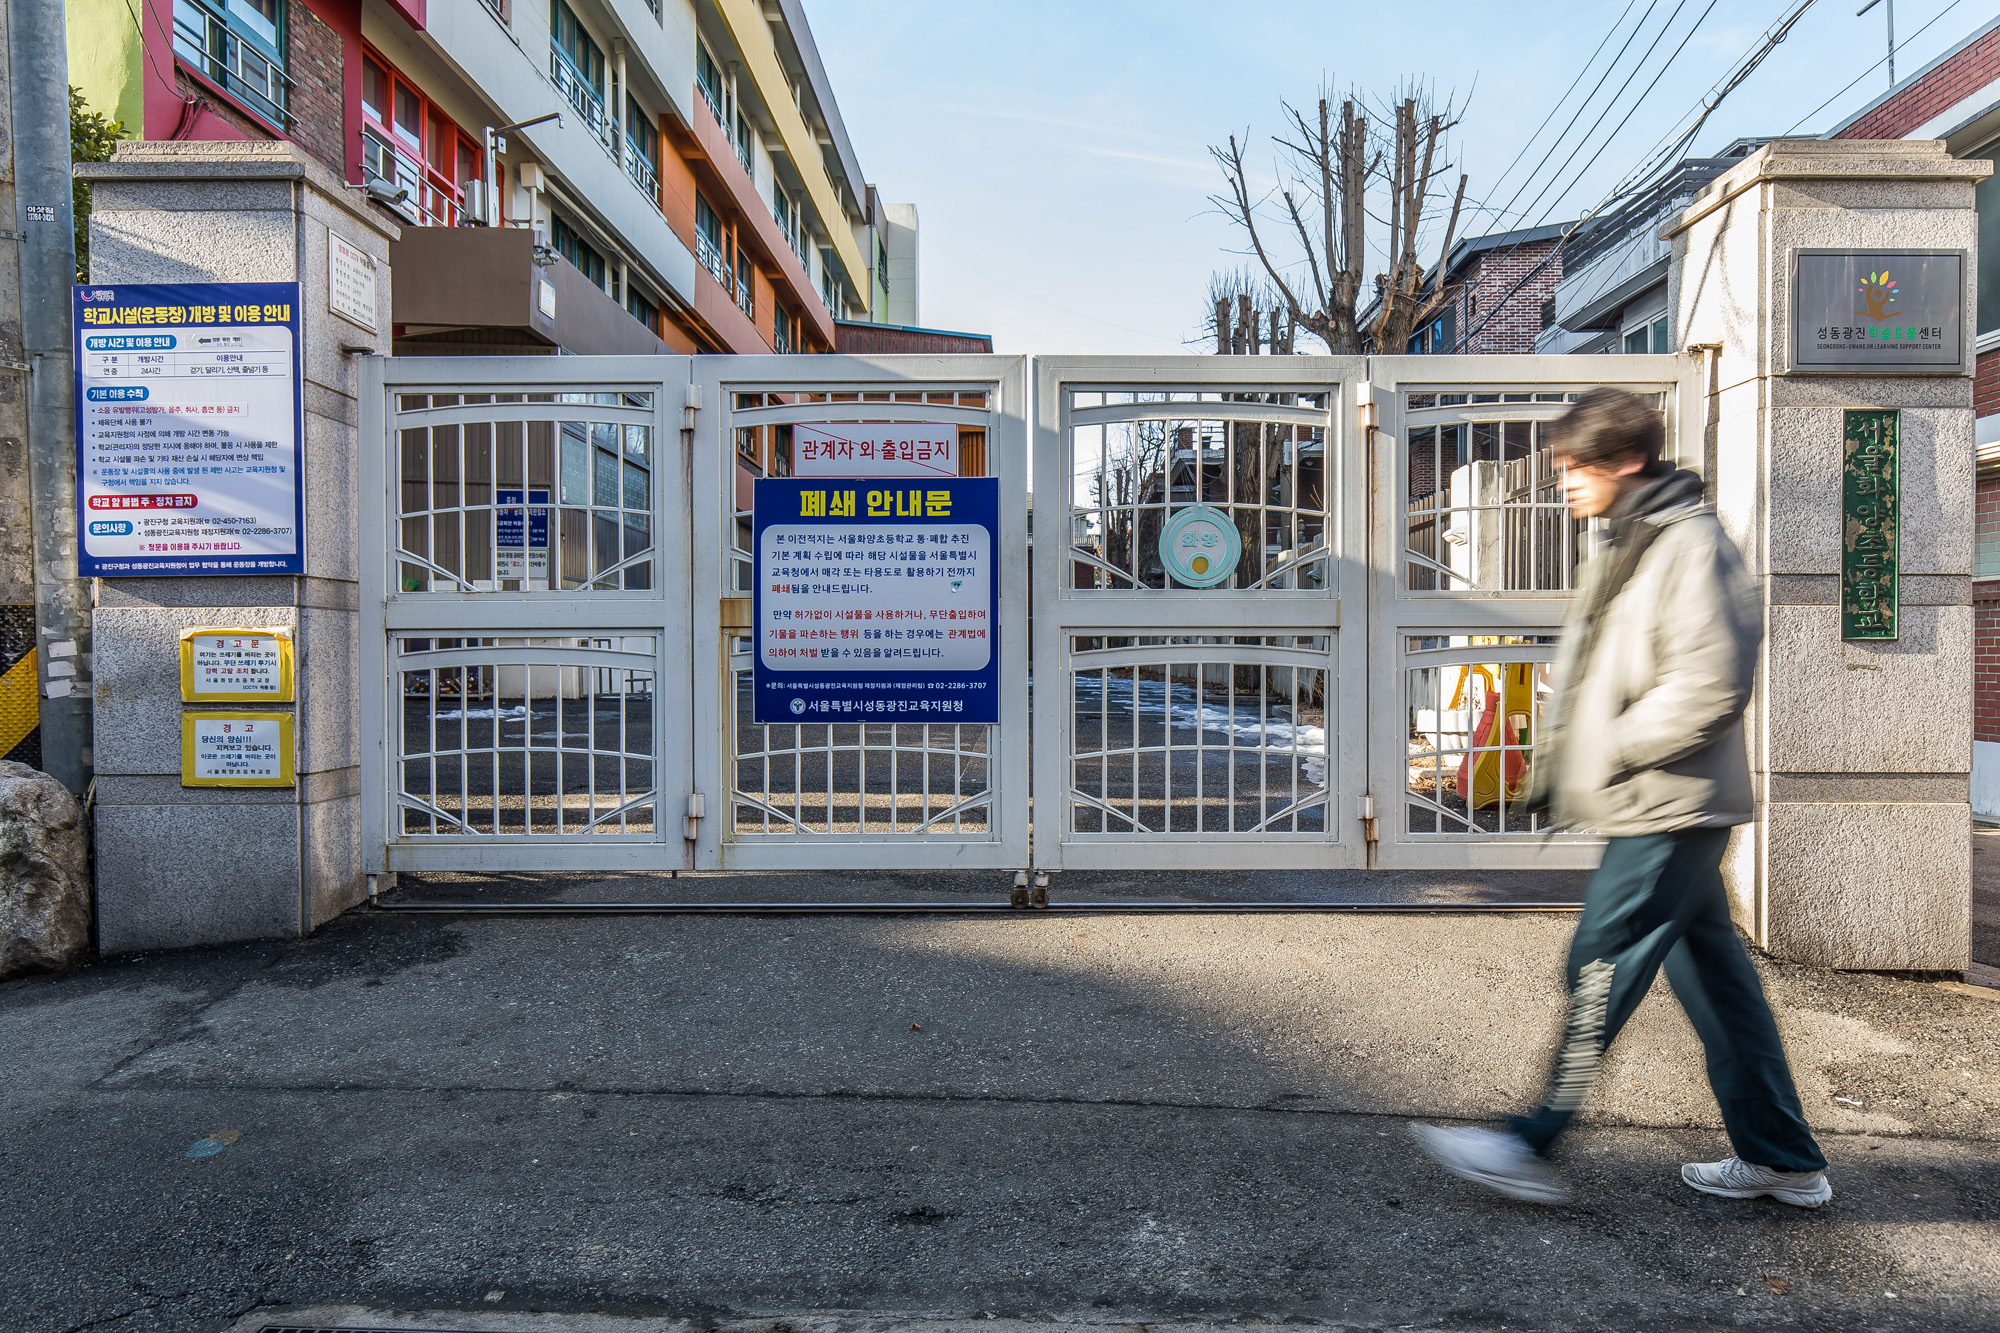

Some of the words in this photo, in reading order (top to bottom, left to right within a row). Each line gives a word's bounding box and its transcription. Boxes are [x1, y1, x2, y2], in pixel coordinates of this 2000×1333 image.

[350, 250, 359, 263] CCTV
[83, 306, 186, 325] 학교시설(운동장)
[188, 305, 216, 323] 개방
[218, 305, 231, 323] 및
[234, 305, 261, 323] 이용
[263, 304, 290, 322] 안내
[1817, 326, 1942, 340] 성동광진학습도움센터
[90, 338, 107, 348] 개방
[108, 338, 124, 348] 시간
[126, 337, 134, 348] 및
[136, 337, 152, 347] 이용
[153, 337, 171, 347] 안내
[217, 354, 243, 362] 이용안내
[141, 367, 161, 375] 24시간
[91, 389, 107, 399] 기본
[109, 389, 125, 399] 이용
[126, 389, 143, 398] 수칙
[97, 406, 110, 414] 소음
[201, 406, 214, 414] 흡연
[216, 406, 225, 414] 등)
[227, 406, 240, 414] 금지
[124, 418, 137, 426] 사용
[139, 418, 152, 426] 불가
[158, 430, 171, 438] 의해
[98, 443, 140, 451] 학교(관리자)의
[162, 442, 181, 450] 지시에
[183, 442, 202, 450] 응해야
[221, 441, 233, 449] 불응
[235, 441, 242, 449] 시
[244, 441, 263, 449] 사용을
[801, 440, 854, 461] 관계자
[859, 440, 875, 461] 외
[881, 440, 950, 461] 출입금지
[92, 497, 109, 508] 학교
[111, 497, 120, 507] 앞
[122, 497, 139, 507] 불법
[175, 496, 192, 506] 금지
[800, 490, 855, 516] 폐쇄
[866, 490, 952, 516] 안내문
[144, 518, 168, 526] 광진구청
[1855, 418, 1885, 630] 서울화양초등학교
[93, 524, 126, 533] 문의사항
[144, 529, 199, 537] 성동광진교육지원청
[776, 534, 785, 544] 본
[788, 534, 835, 544] 이전적지는
[838, 534, 914, 544] 서울화양초등학교
[951, 534, 969, 544] 추진
[1182, 532, 1218, 547] 화양
[170, 543, 190, 551] 이용해
[192, 543, 212, 551] 주시기
[213, 542, 242, 550] 바랍니다.
[772, 551, 790, 560] 기본
[793, 551, 811, 560] 계획
[814, 551, 842, 560] 수립에
[845, 551, 864, 560] 따라
[868, 551, 886, 560] 해당
[889, 551, 927, 560] 시설물을
[930, 550, 977, 560] 서울특별시
[771, 567, 819, 577] 교육청에서
[822, 567, 840, 577] 매각
[843, 567, 861, 577] 또는
[864, 567, 902, 577] 타용도로
[906, 567, 944, 577] 활용하기
[947, 567, 975, 577] 전까지
[771, 584, 809, 594] 폐쇄됨을
[812, 584, 872, 594] 안내드립니다.
[773, 610, 792, 620] 만약
[794, 610, 832, 620] 허가없이
[835, 610, 872, 620] 시설물을
[875, 610, 926, 620] 사용하거나,
[929, 610, 986, 620] 무단출입하여
[769, 629, 797, 639] 기물을
[800, 629, 838, 639] 파손하는
[840, 629, 859, 639] 행위
[863, 629, 882, 639] 등을
[885, 629, 903, 639] 하는
[906, 629, 944, 639] 경우에는
[948, 629, 986, 639] 관계법에
[769, 648, 796, 658] 의하여
[800, 648, 818, 658] 처벌
[821, 648, 839, 658] 받을
[842, 648, 851, 658] 수
[854, 648, 881, 658] 있음을
[883, 648, 944, 658] 알려드립니다.
[808, 700, 963, 712] 서울특별시성동광진교육지원청
